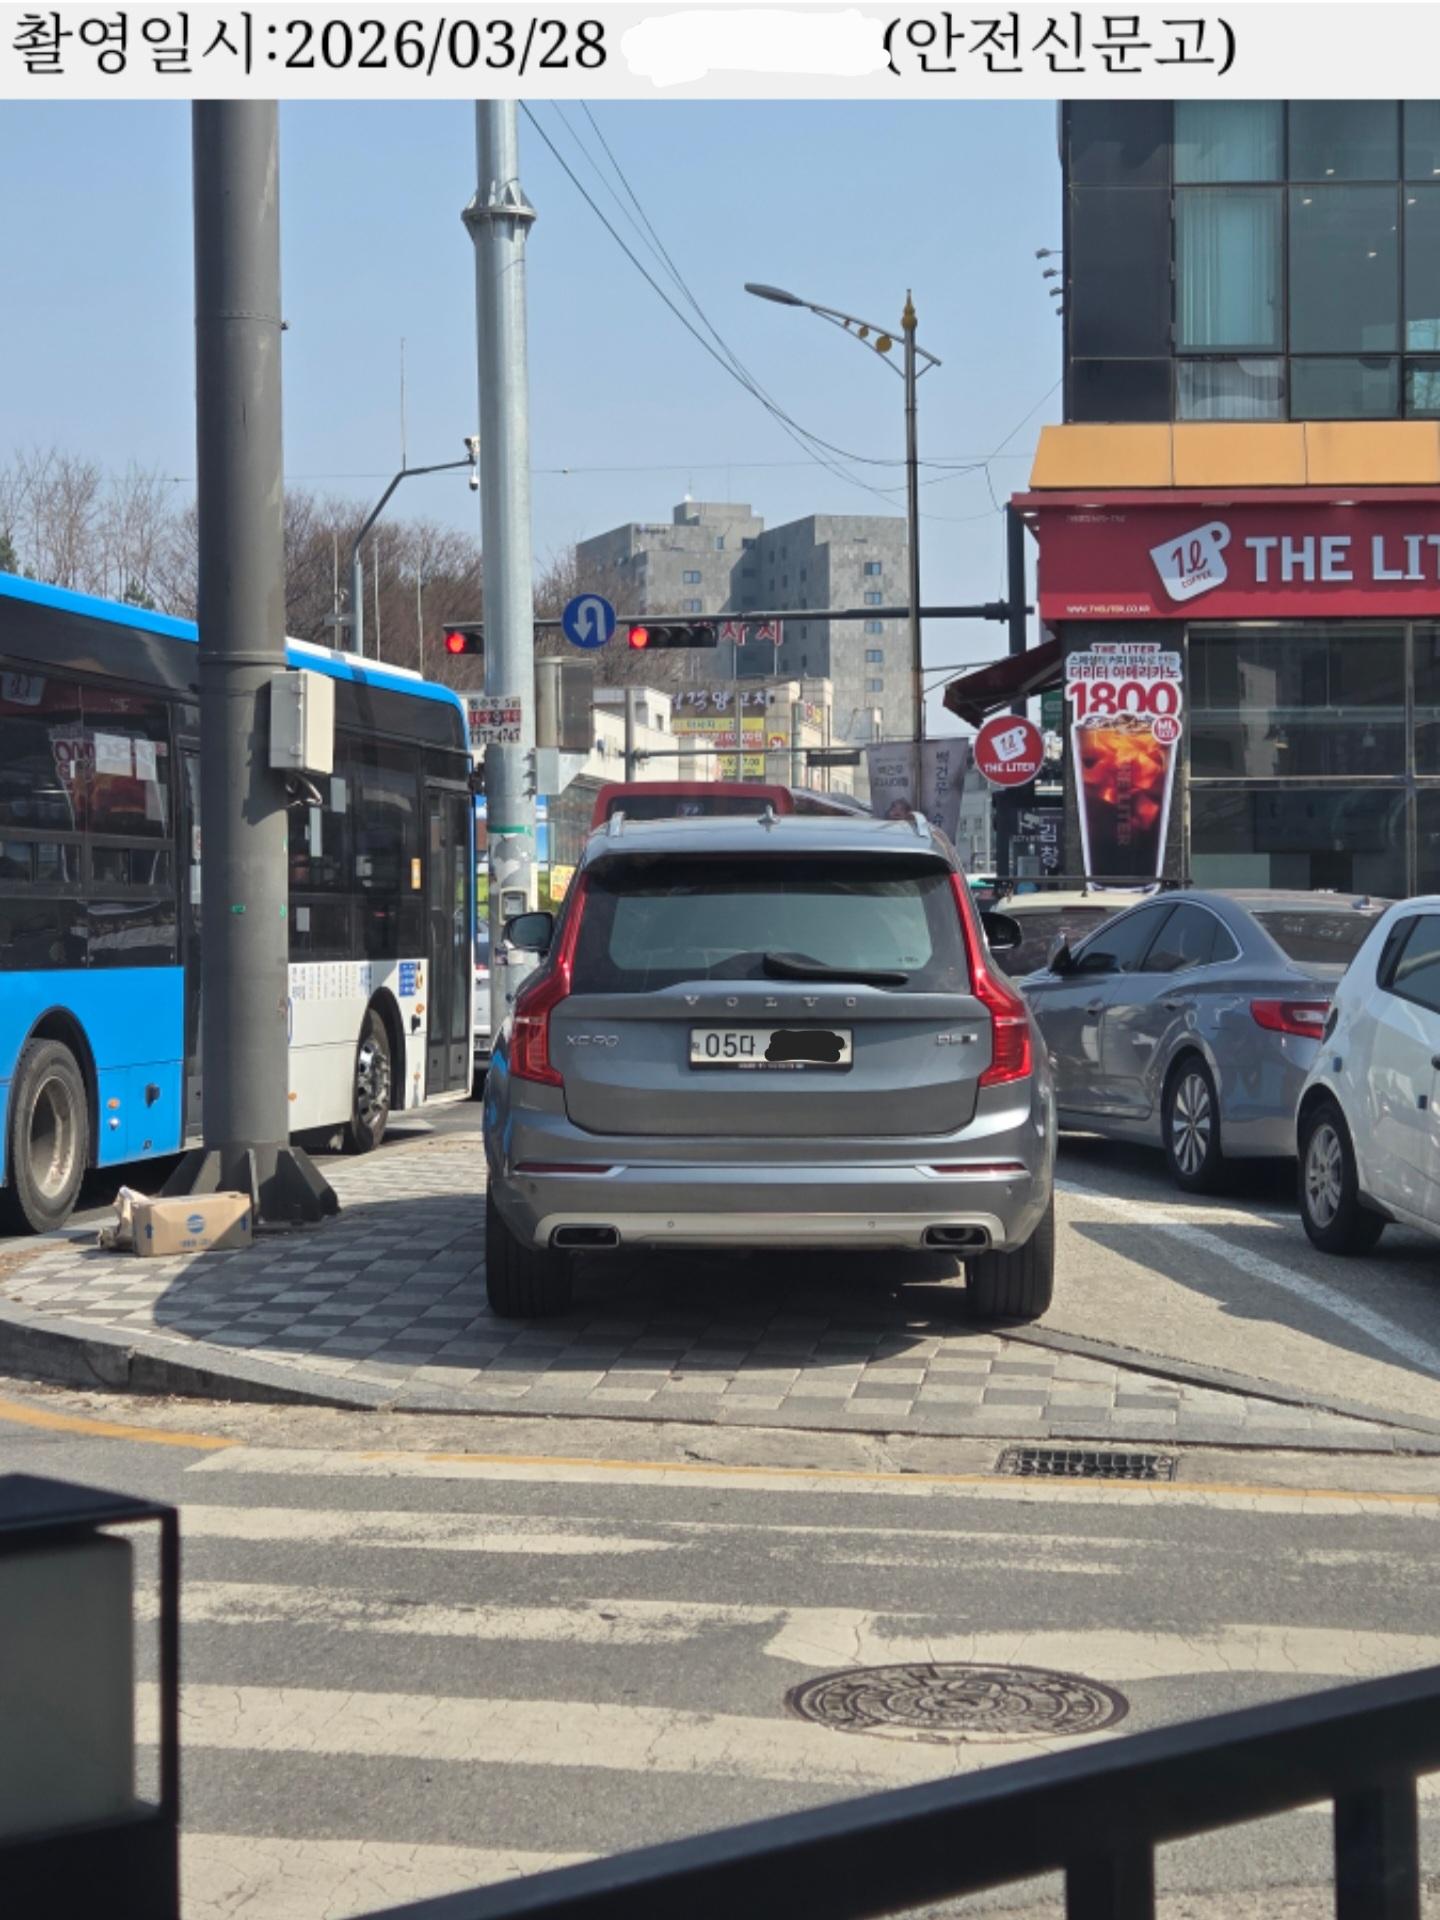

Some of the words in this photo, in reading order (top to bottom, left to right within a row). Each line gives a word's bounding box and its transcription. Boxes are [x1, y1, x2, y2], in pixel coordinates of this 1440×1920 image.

[1245, 535, 1354, 582] THE
[1181, 569, 1213, 589] COFFEE
[1095, 645, 1116, 654] THE
[1121, 645, 1156, 654] LITER
[1070, 666, 1108, 681] 더리터
[1113, 665, 1178, 680] 아메리카노
[1070, 681, 1179, 721] 1800
[984, 763, 1003, 773] THE
[1006, 762, 1036, 772] LITER
[1117, 792, 1131, 847] LITER
[684, 995, 857, 1007] VOLVO
[566, 1035, 620, 1048] XC90
